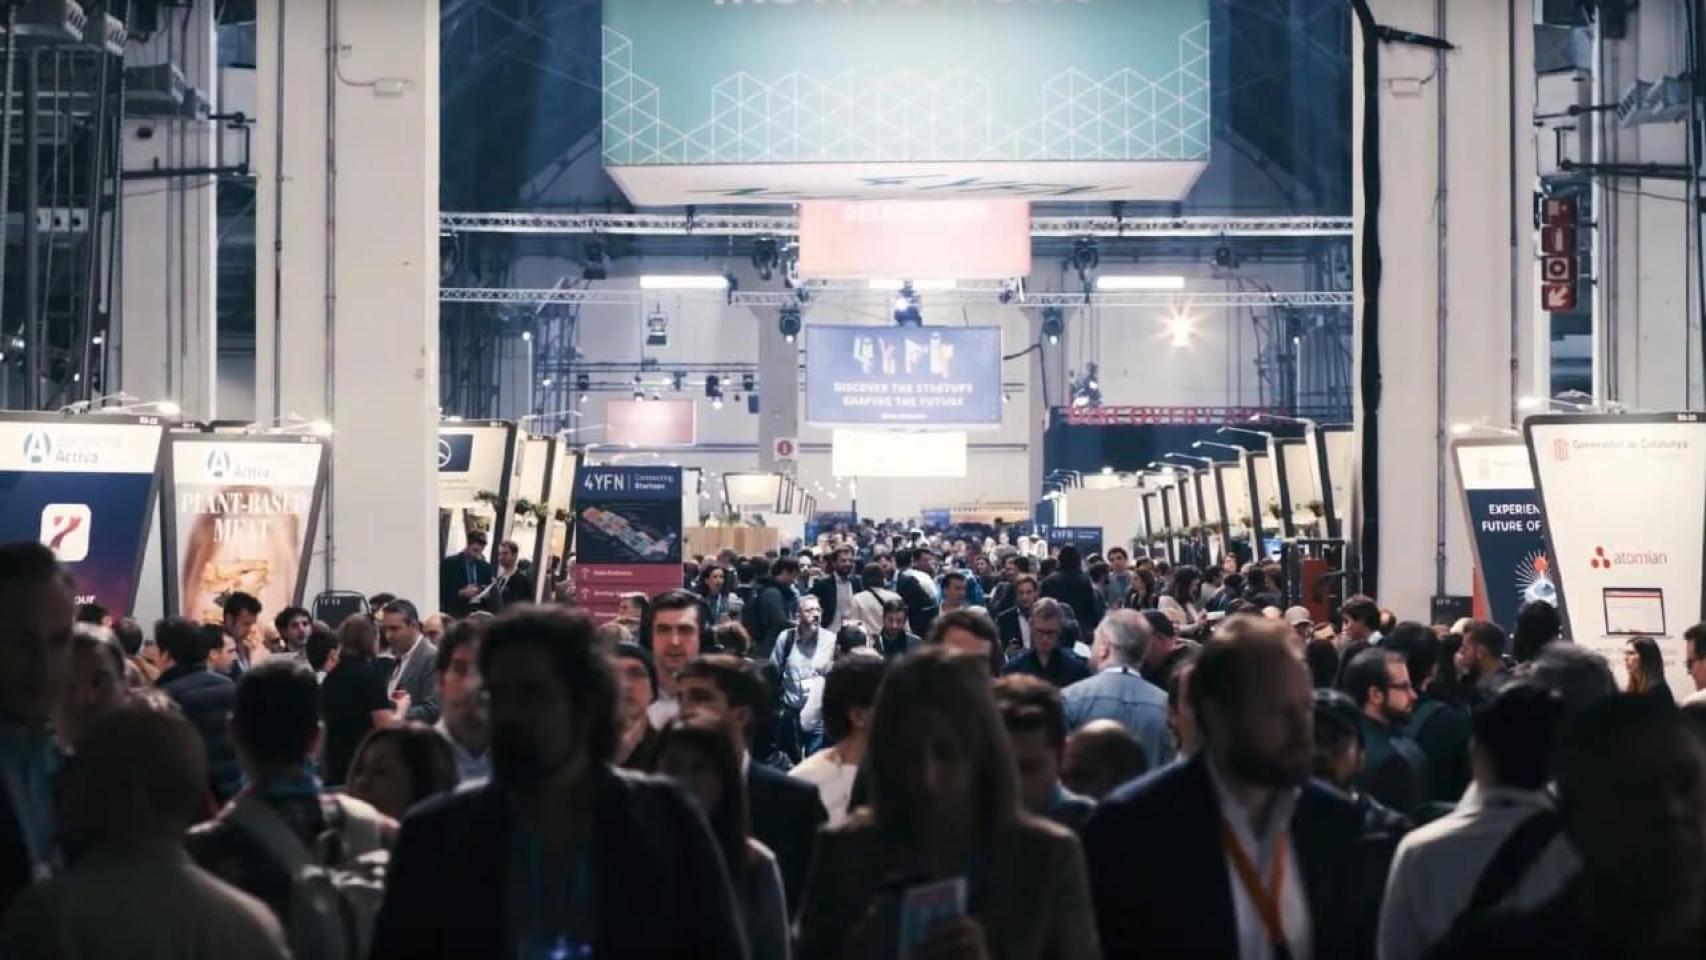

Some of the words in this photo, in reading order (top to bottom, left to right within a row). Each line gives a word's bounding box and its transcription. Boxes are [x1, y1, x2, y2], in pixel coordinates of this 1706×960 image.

[833, 382, 888, 393] DISCOVER
[892, 382, 913, 393] THE
[916, 382, 974, 393] STARTUPS
[843, 396, 891, 407] SHAPING
[895, 396, 917, 407] THE
[920, 396, 965, 407] FUTURE
[56, 449, 99, 464] Activa
[584, 473, 625, 490] 4YFN
[213, 518, 269, 543] MEAT
[1482, 520, 1523, 532] FUTURE
[1527, 520, 1541, 532] OF
[1614, 549, 1668, 565] atomian
